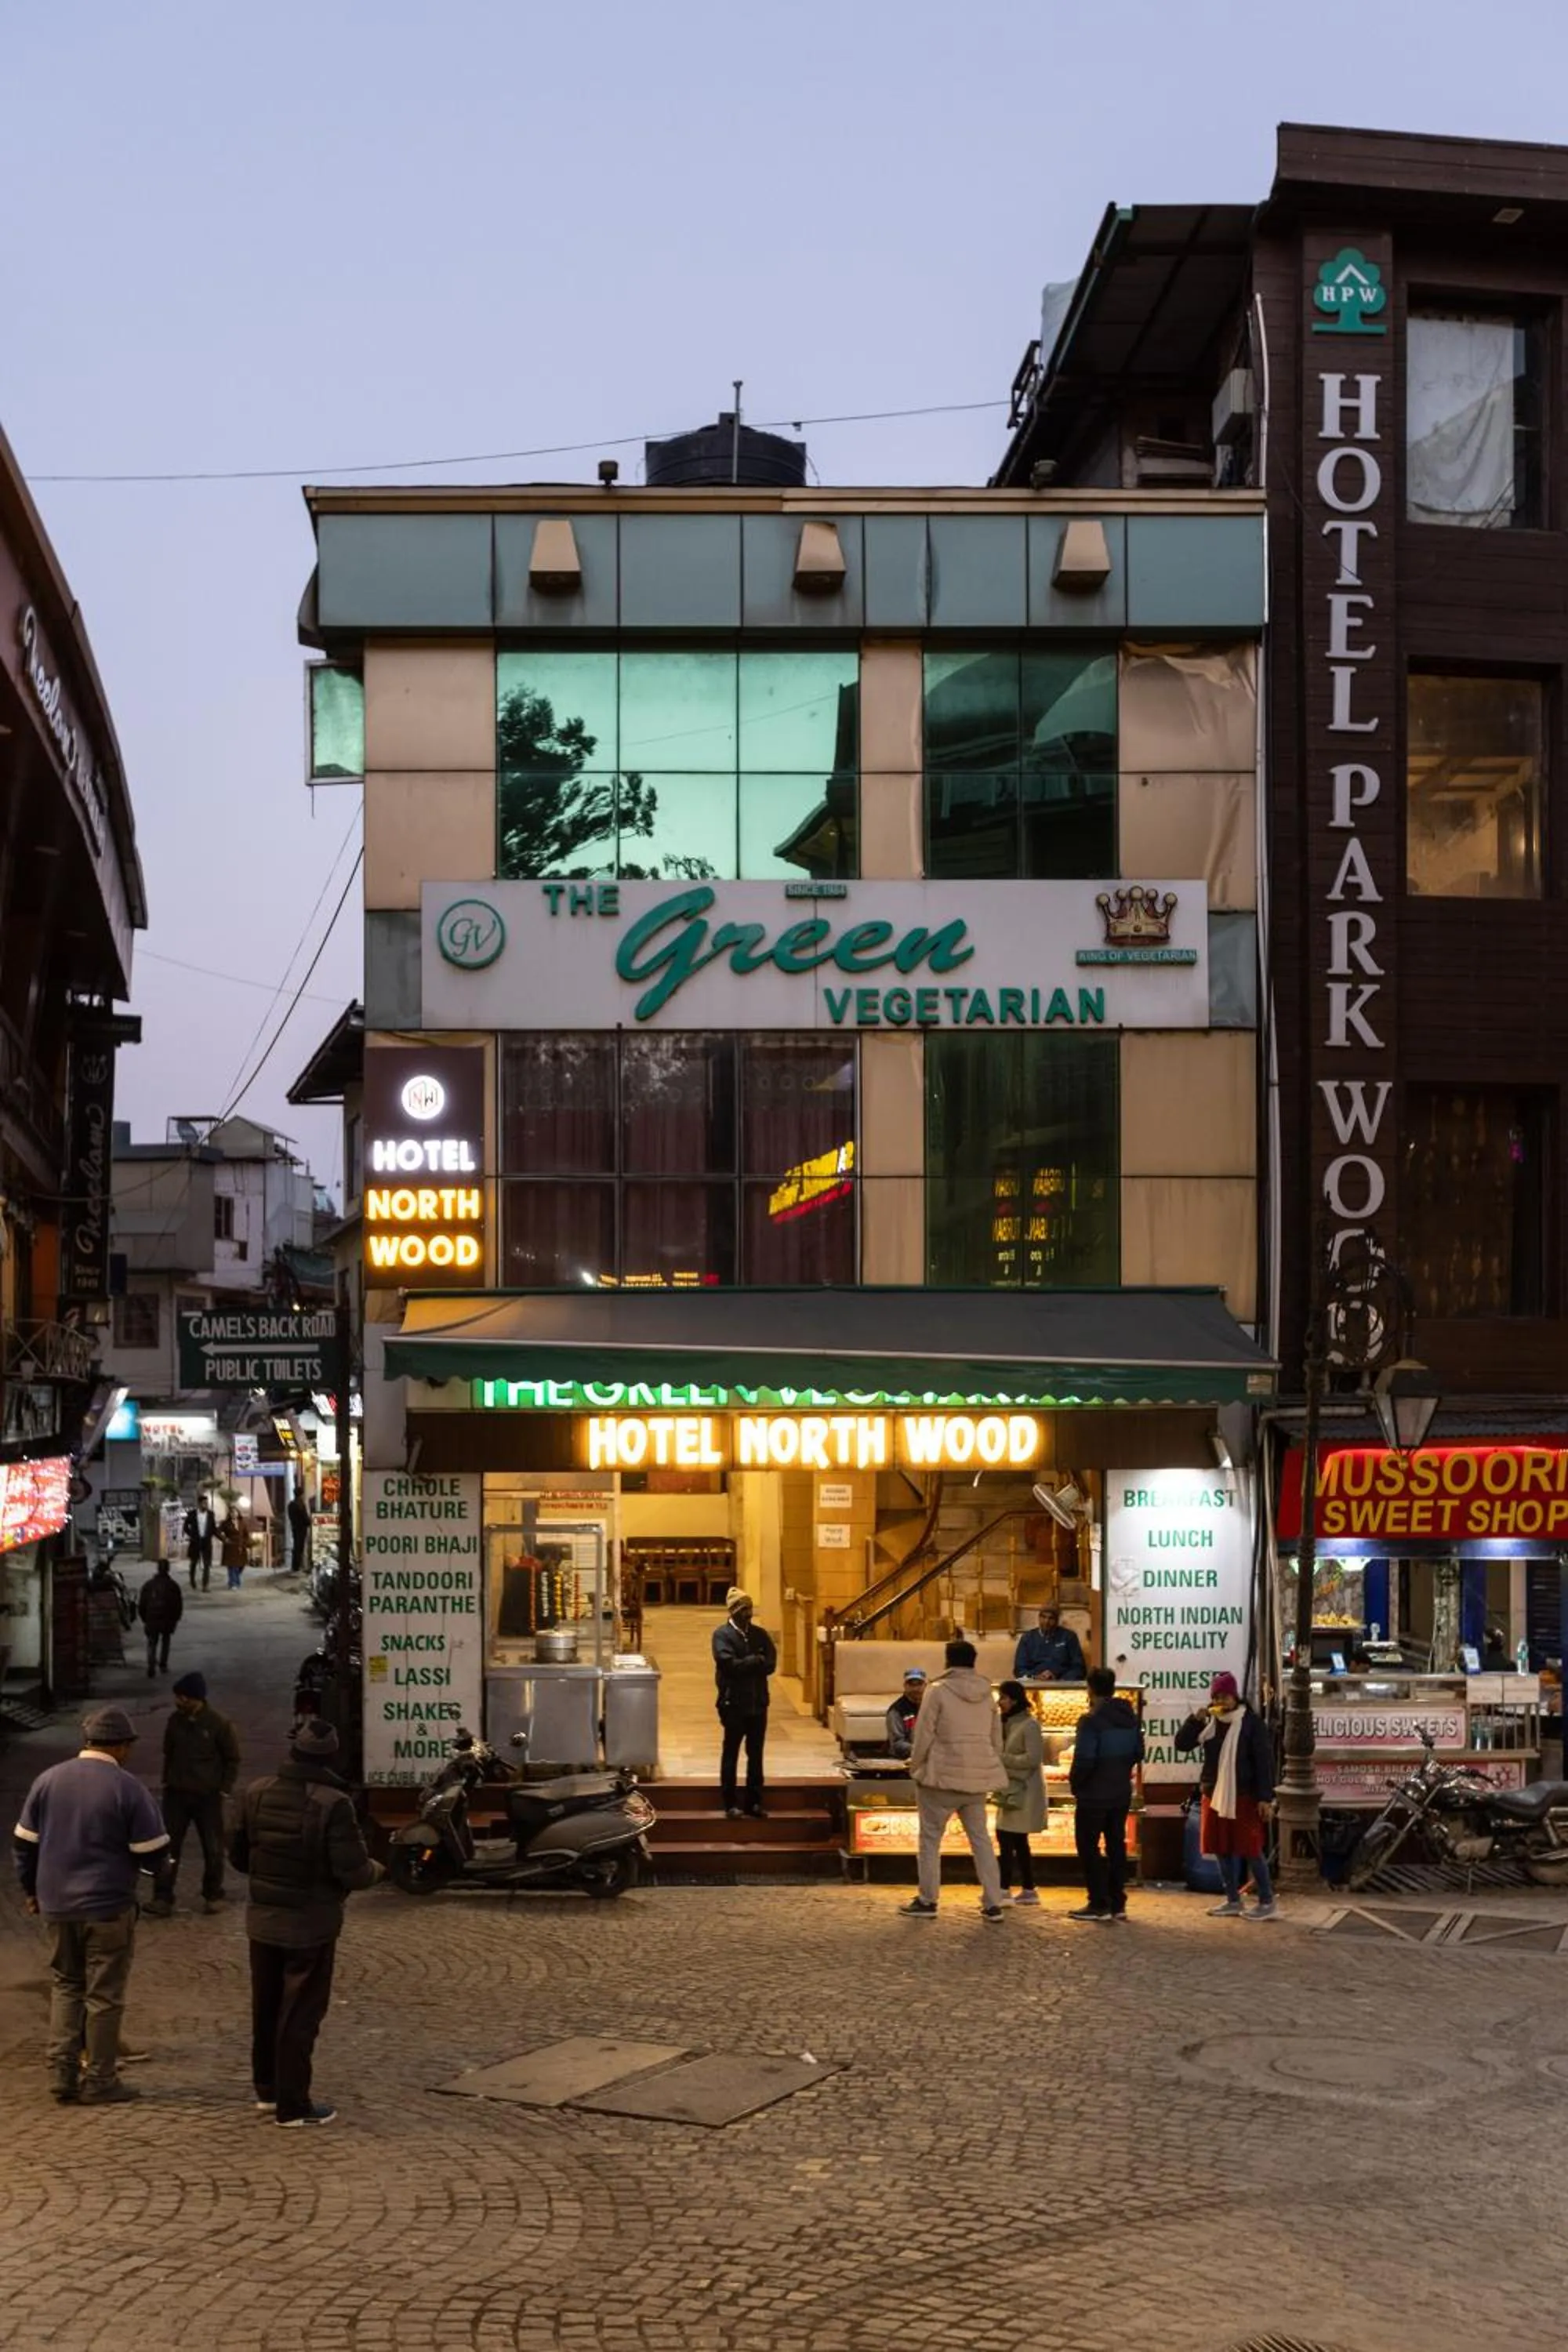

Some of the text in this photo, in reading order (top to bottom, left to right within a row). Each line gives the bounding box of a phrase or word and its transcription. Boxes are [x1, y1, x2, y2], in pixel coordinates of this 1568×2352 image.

[1317, 372, 1382, 733] HOTEL
[543, 884, 619, 916] THE
[1325, 764, 1386, 1048] PARK
[615, 886, 975, 1021] Green
[823, 988, 1105, 1025] VEGETARIAN
[373, 1139, 476, 1171] HOTEL
[368, 1189, 481, 1221] NORTH
[369, 1235, 480, 1267] WOOD
[189, 1314, 336, 1338] CAMEL'S BACK ROAD
[205, 1359, 321, 1381] PUBLIC TOILETS
[589, 1415, 1040, 1468] HOTEL NORTH WOOD
[376, 1501, 468, 1519] BHATURE
[1322, 1500, 1568, 1533] SWEET SHOP
[365, 1536, 477, 1554] POORI BHAJI
[1148, 1530, 1213, 1548] LUNCH
[372, 1572, 473, 1589] TANDOORI
[1143, 1570, 1218, 1588] DINNER
[368, 1595, 476, 1613] PARANTHE
[1117, 1607, 1243, 1625] NORTH INDIAN
[381, 1635, 445, 1652] SNACKS
[1131, 1632, 1229, 1650] SPECIALITY
[394, 1668, 451, 1686] LASSI
[383, 1702, 462, 1720] SHAKES
[416, 1723, 427, 1736] &
[1313, 1718, 1387, 1738] ELICIOUS
[394, 1740, 452, 1759] MORE
